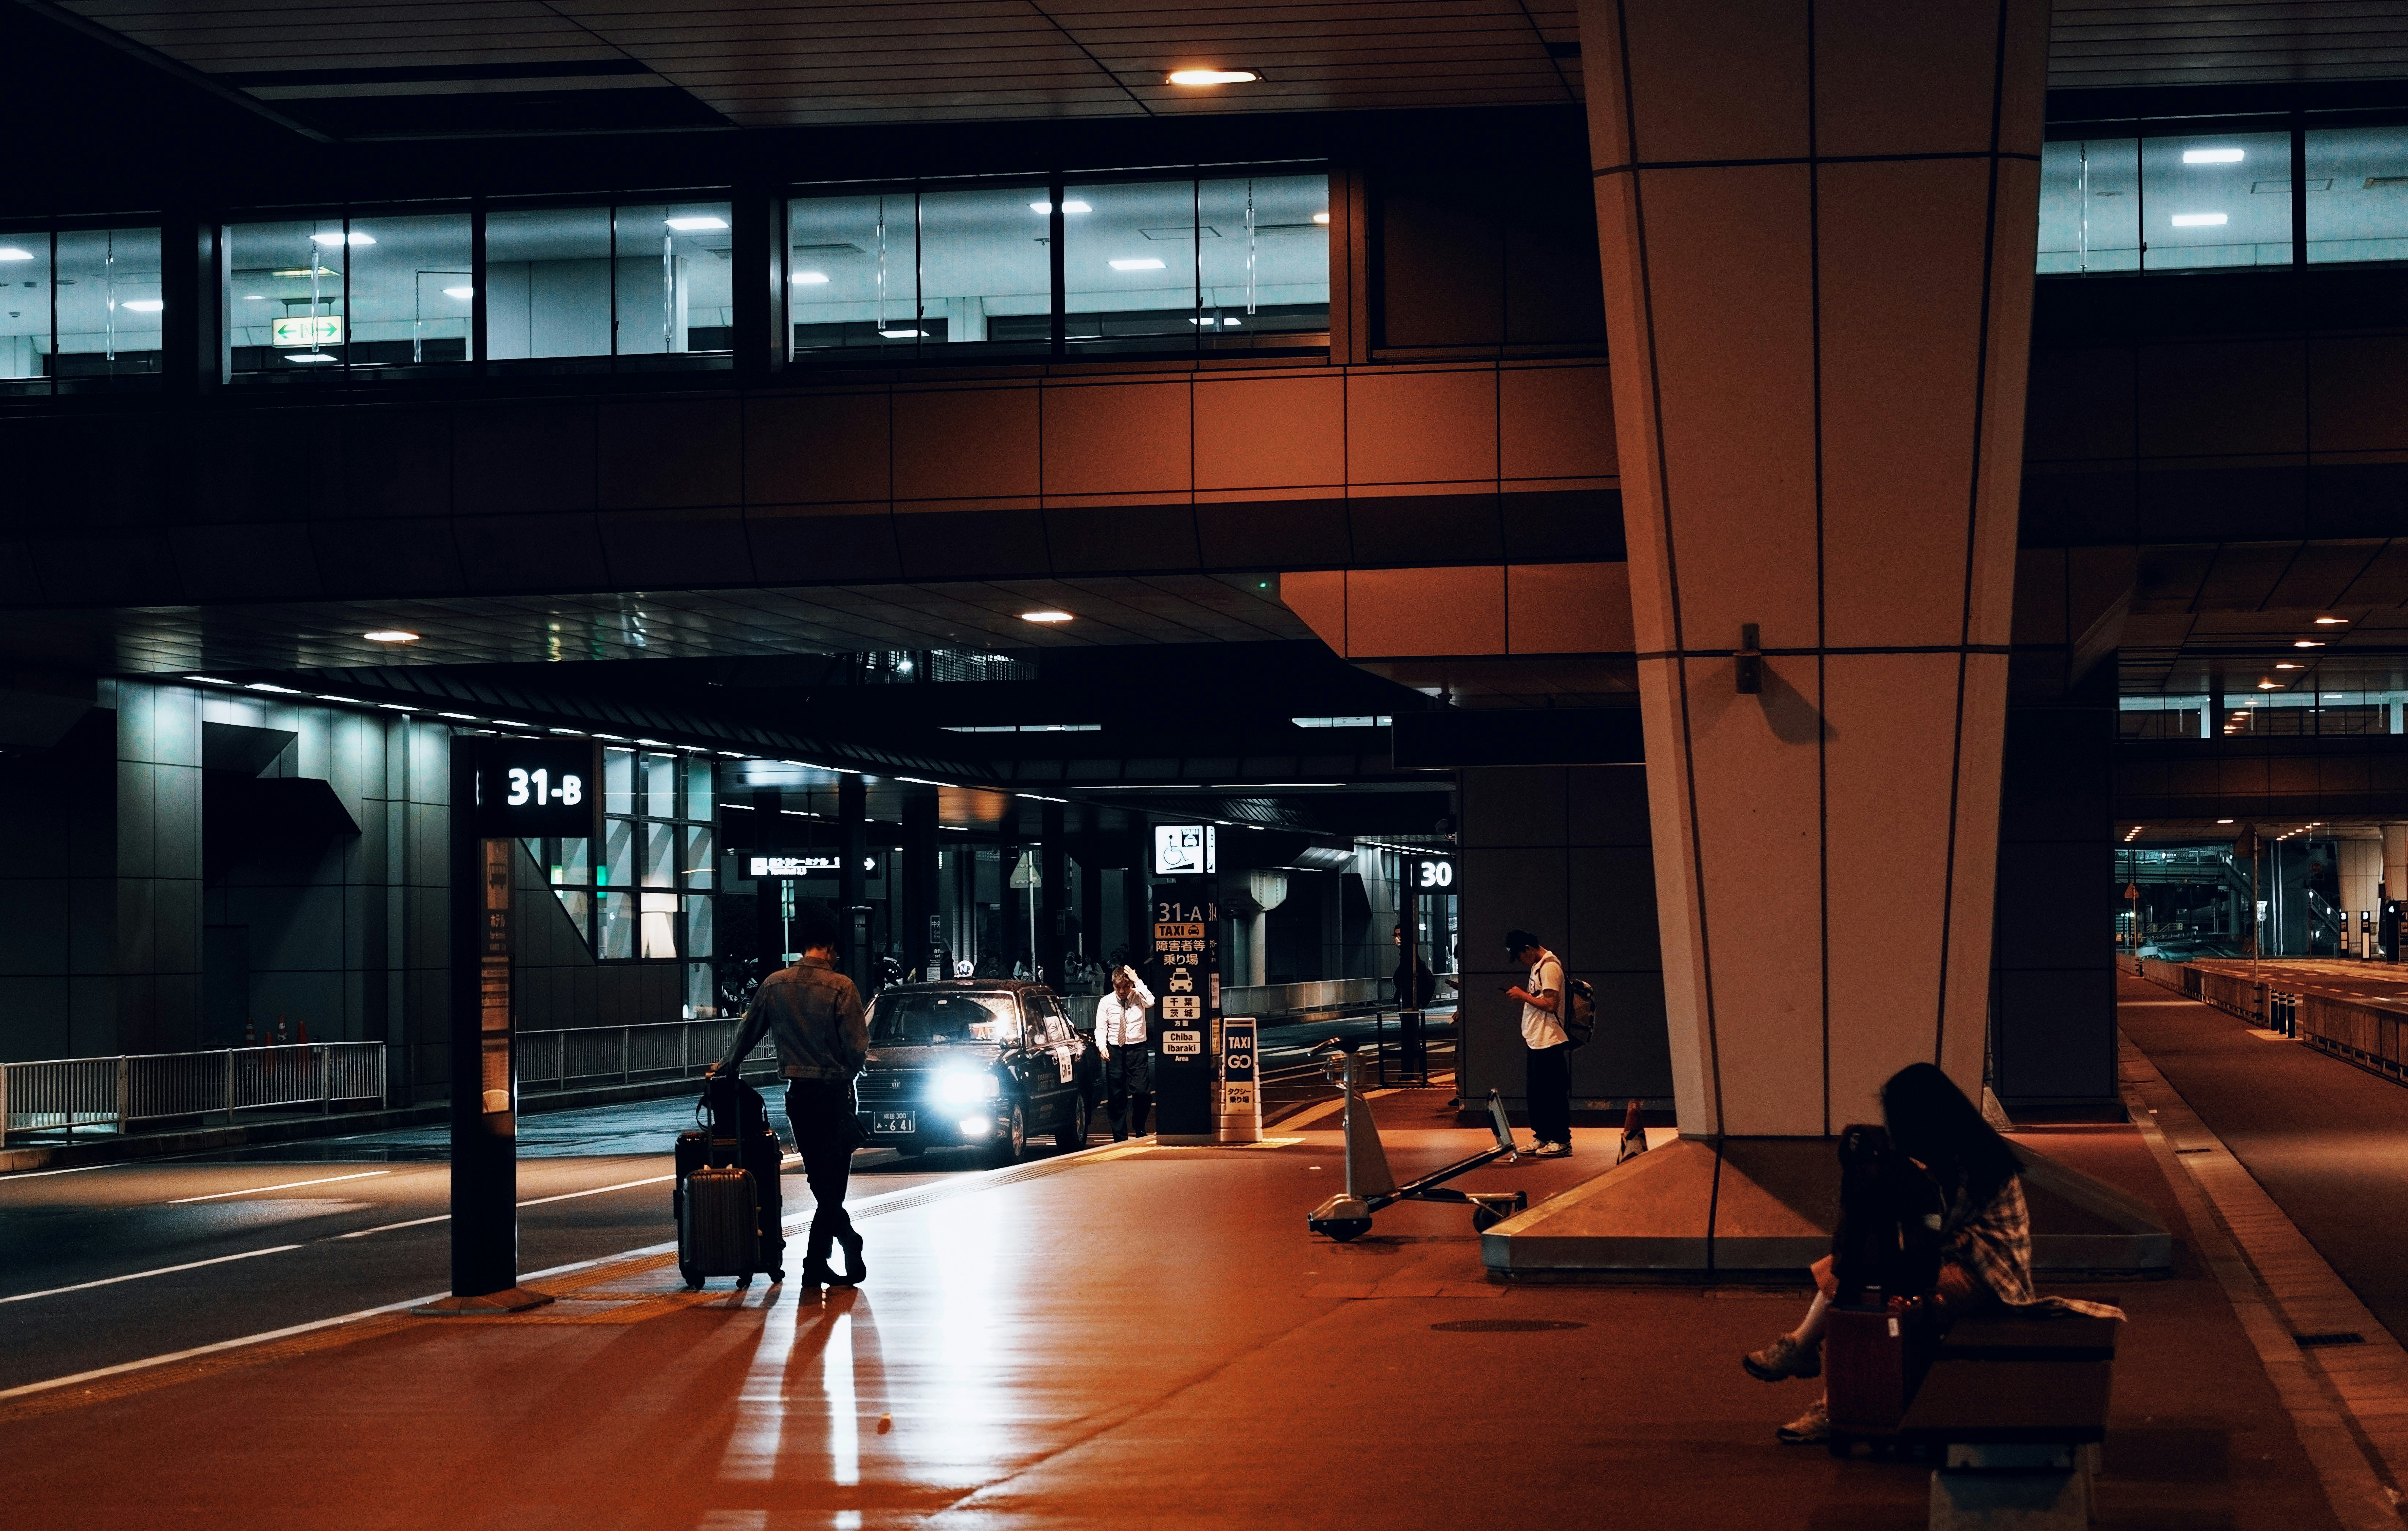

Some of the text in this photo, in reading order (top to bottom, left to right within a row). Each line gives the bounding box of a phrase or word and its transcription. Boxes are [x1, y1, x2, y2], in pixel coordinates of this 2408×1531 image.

[507, 768, 582, 806] 31-B
[1420, 862, 1452, 887] 30
[1159, 903, 1202, 922] 31-A
[1159, 926, 1184, 936] TAXI
[1156, 940, 1205, 952] 障害者等
[1163, 954, 1198, 965] 乗り場
[1170, 1033, 1193, 1041] Chiba
[1228, 1037, 1250, 1049] TAXI
[1168, 1044, 1196, 1052] Ibaraki
[1228, 1054, 1251, 1069] GO
